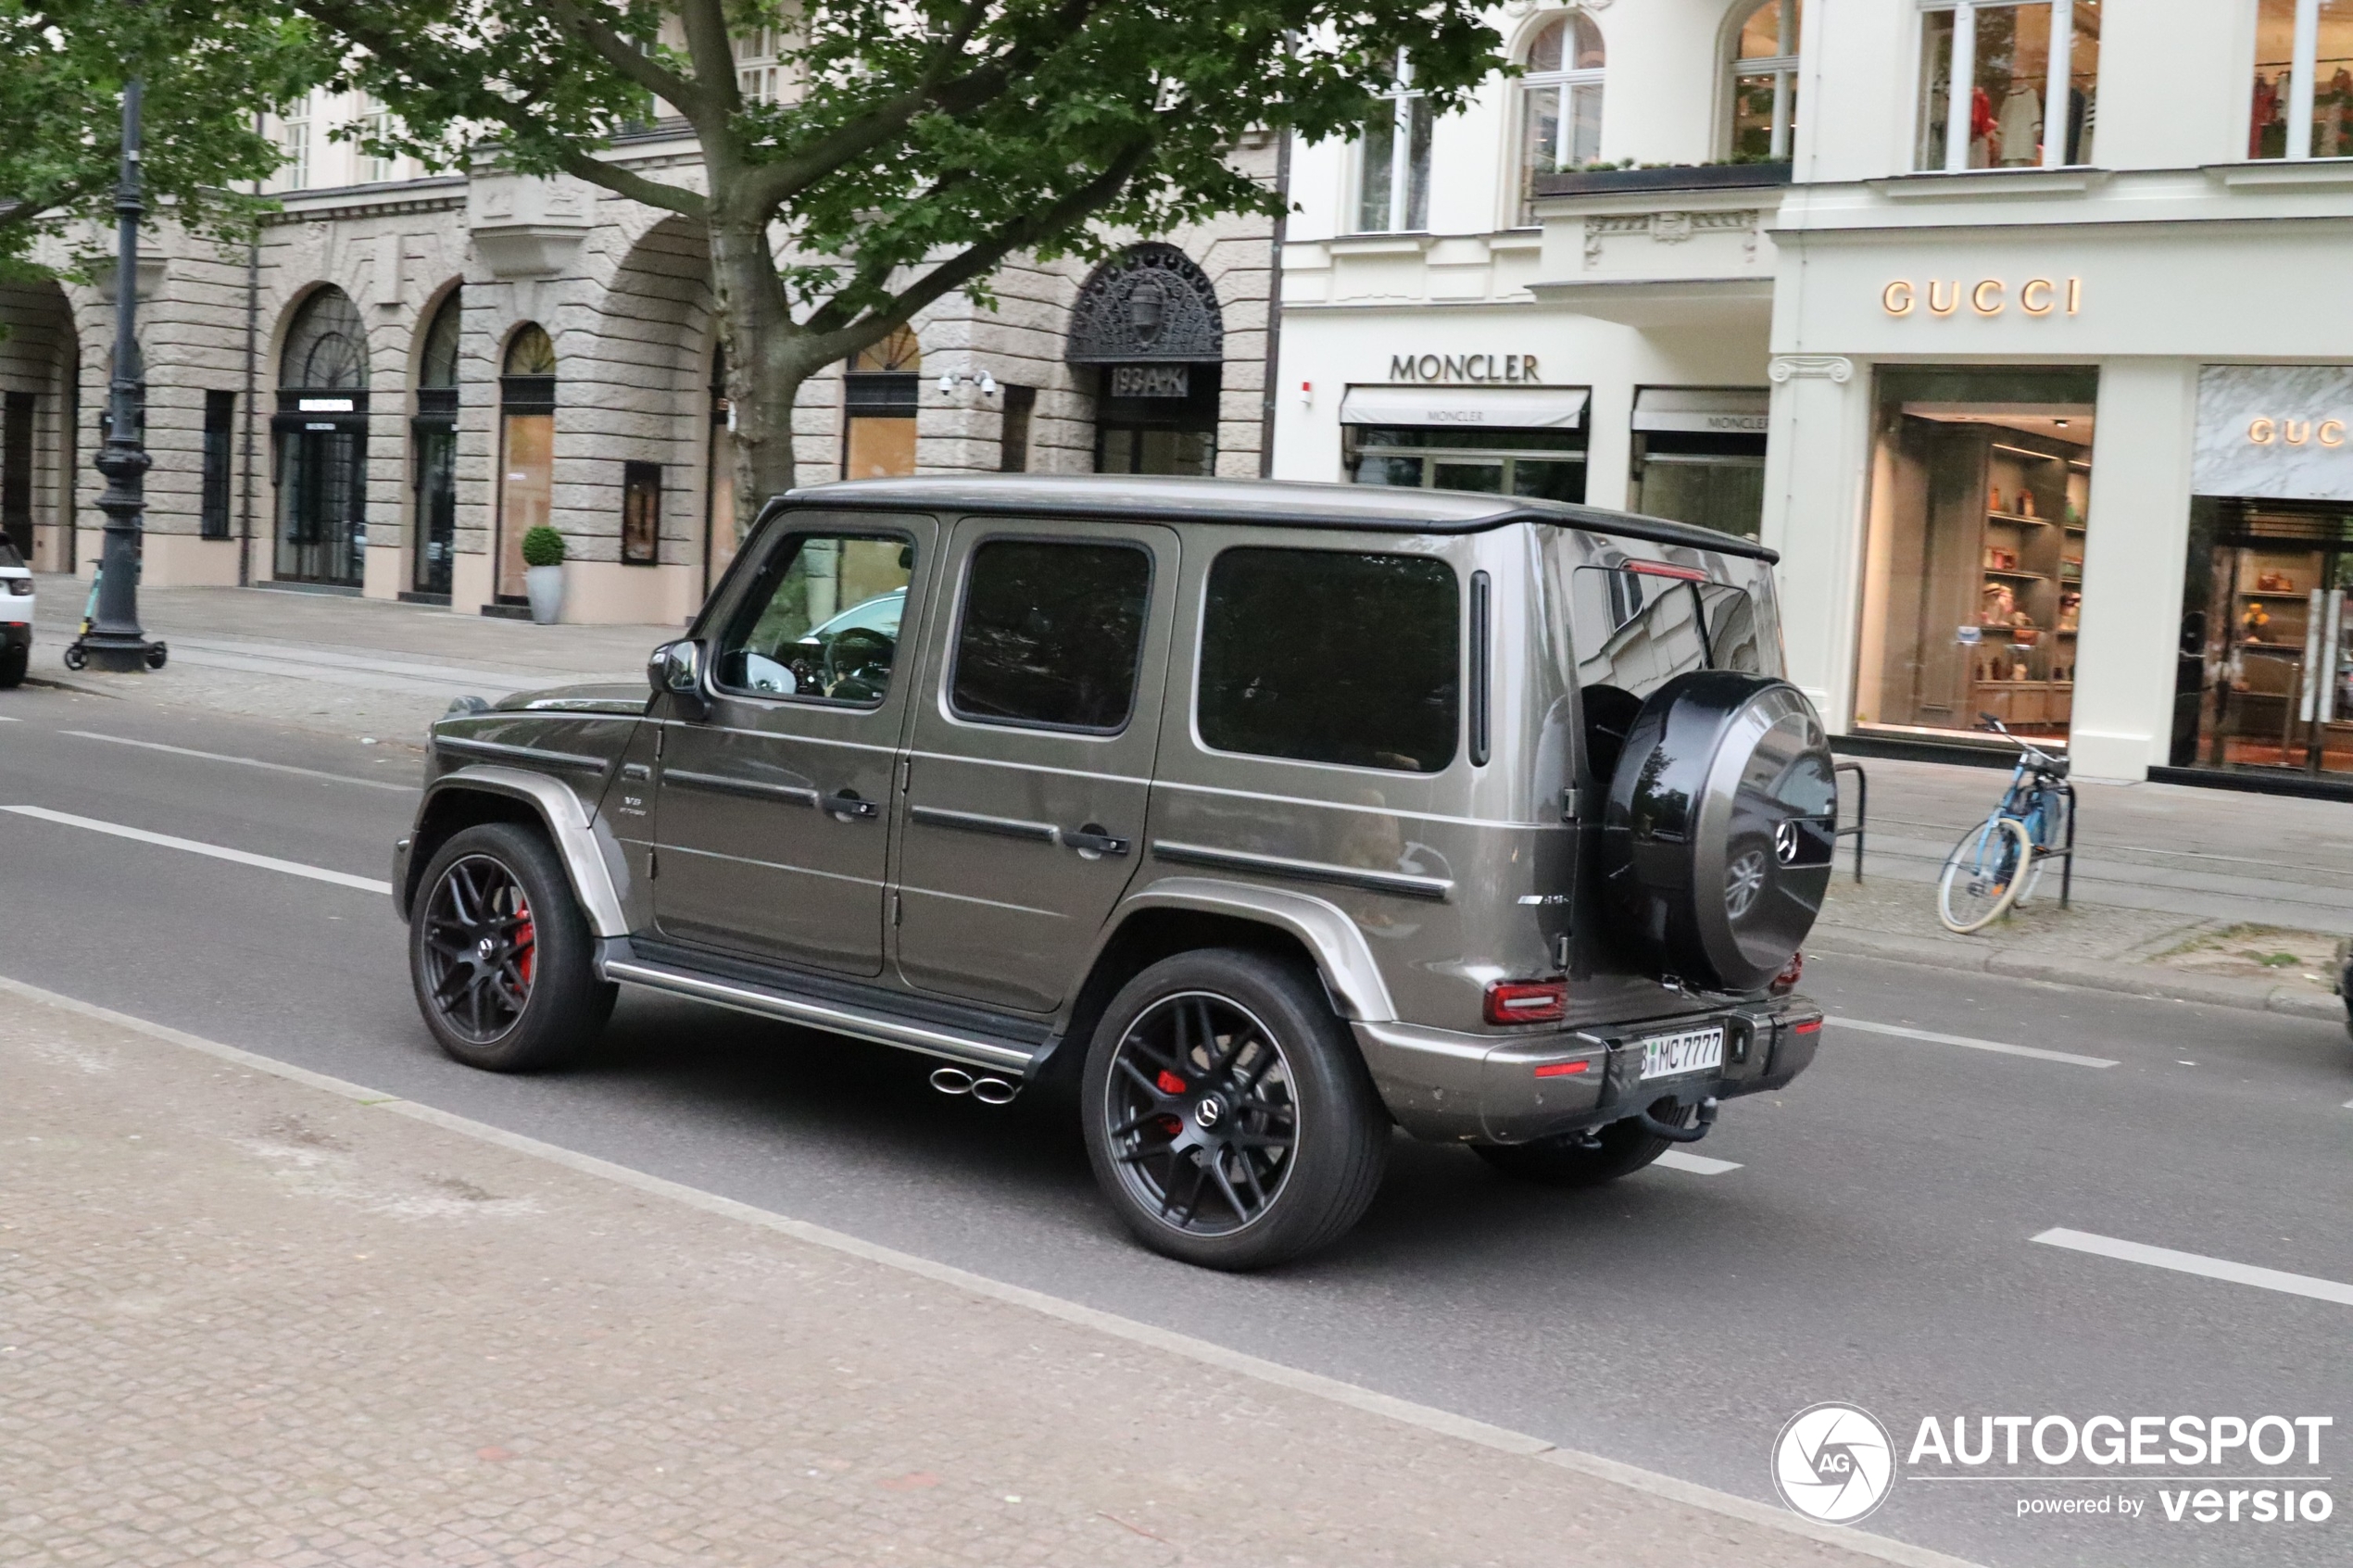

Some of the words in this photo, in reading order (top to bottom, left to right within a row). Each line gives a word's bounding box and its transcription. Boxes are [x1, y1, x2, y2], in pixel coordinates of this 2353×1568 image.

[1882, 278, 2082, 317] GUCCI
[1390, 355, 1540, 381] MONCLER
[1427, 410, 1484, 422] MONCLER
[2247, 418, 2346, 446] GUC
[1658, 1038, 1679, 1072] MC
[1683, 1032, 1720, 1067] 7777
